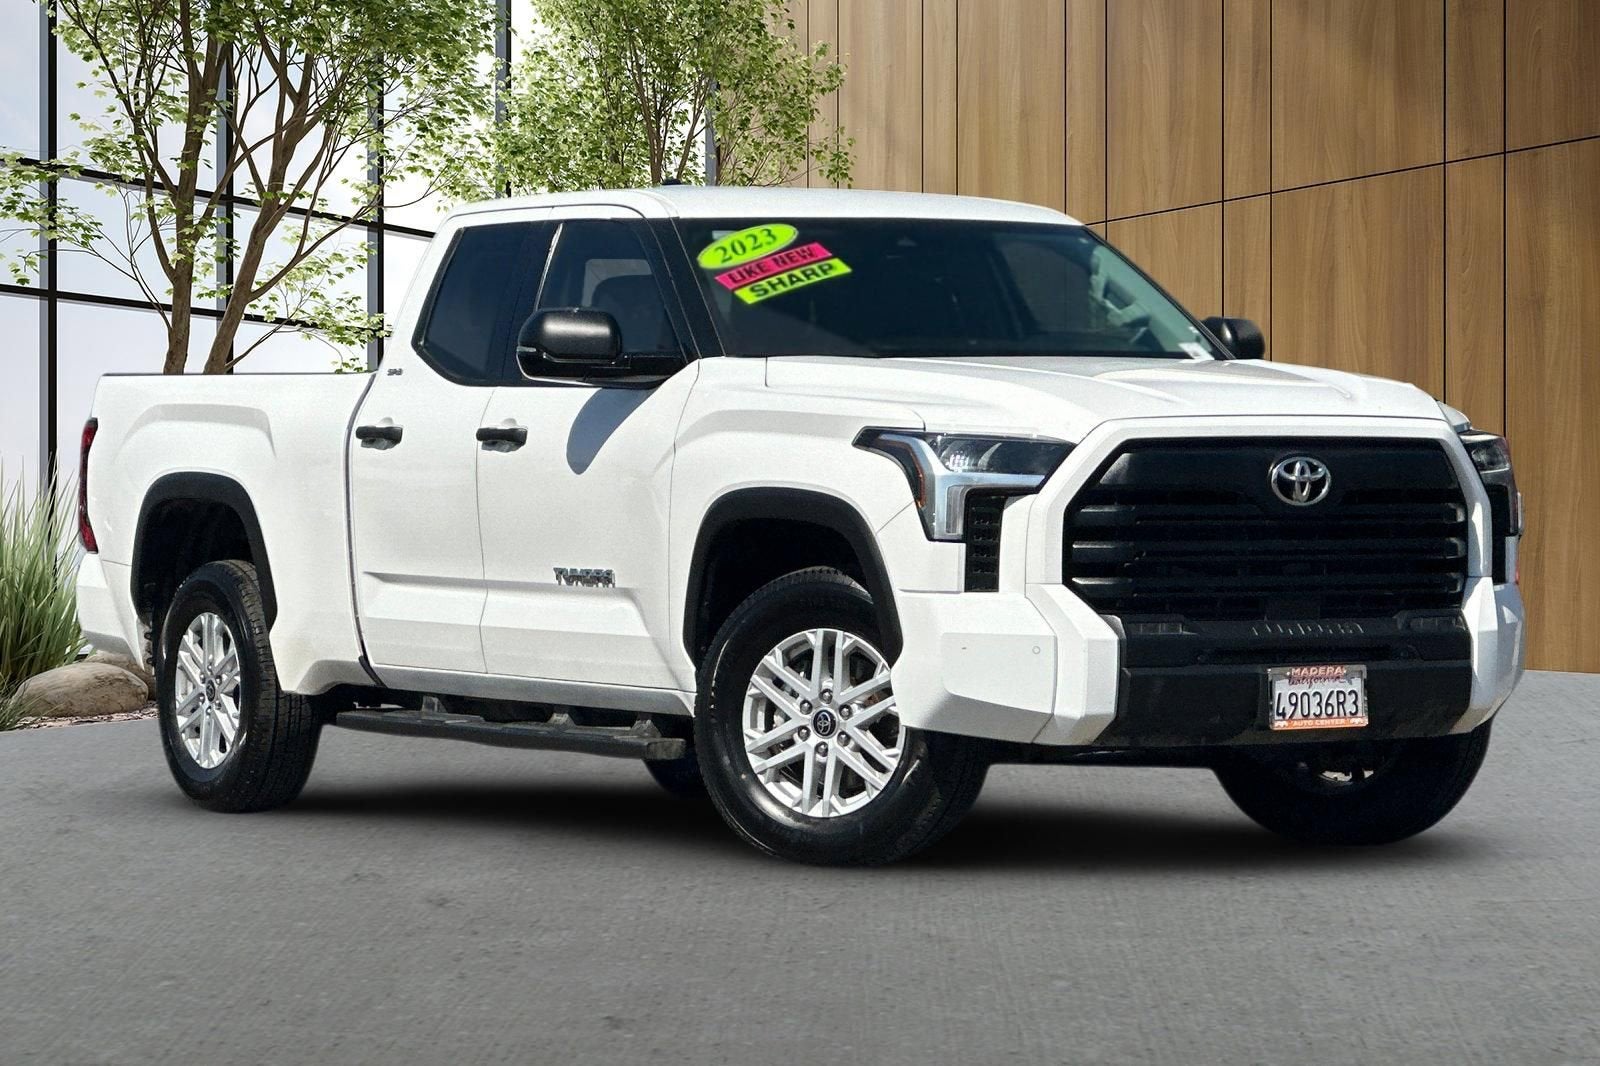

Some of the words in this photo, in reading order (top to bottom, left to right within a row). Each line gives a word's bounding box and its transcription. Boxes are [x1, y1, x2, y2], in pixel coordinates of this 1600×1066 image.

[714, 228, 778, 264] 2023
[727, 261, 771, 284] LIKE
[772, 245, 817, 268] NEW
[750, 262, 835, 298] SHARP
[1291, 665, 1343, 677] MADERA
[1275, 689, 1360, 719] 49036R3
[1315, 719, 1346, 727] CENTER
